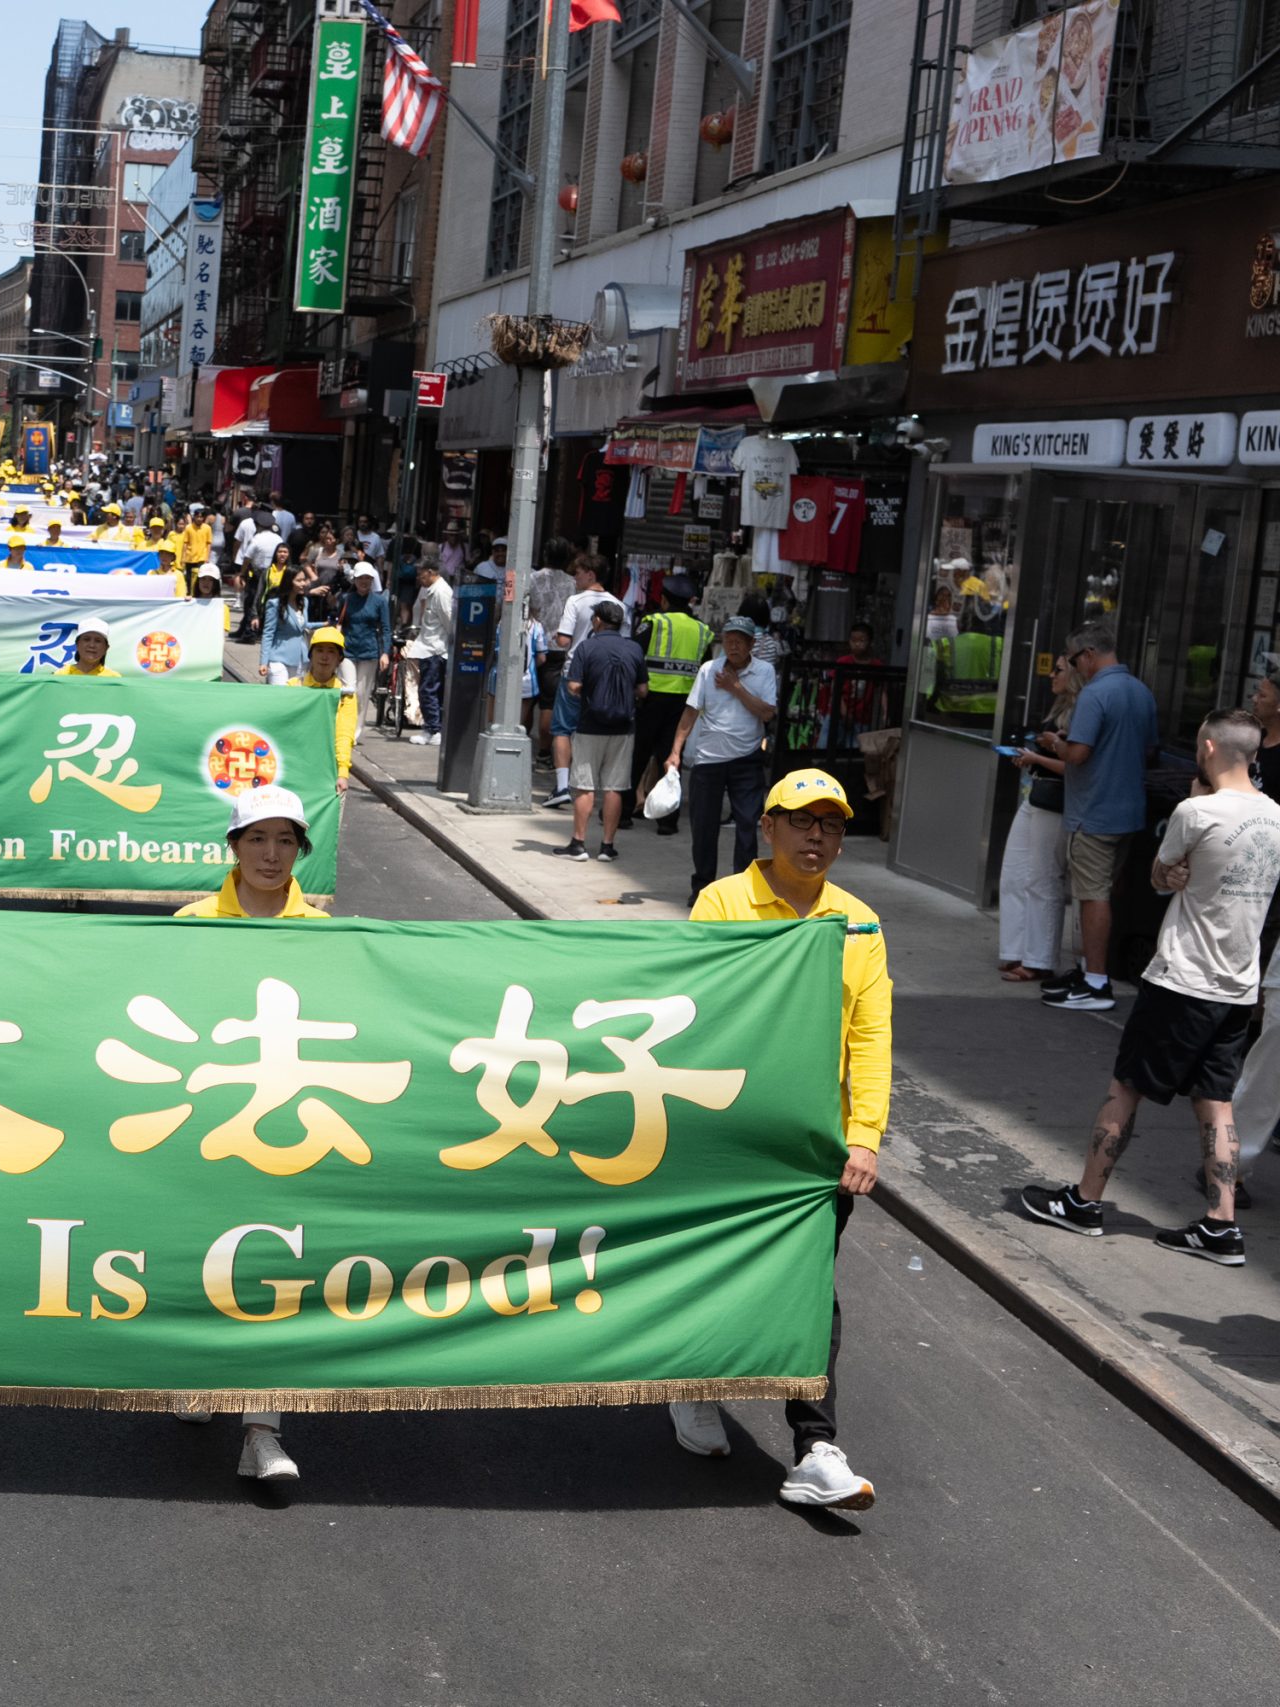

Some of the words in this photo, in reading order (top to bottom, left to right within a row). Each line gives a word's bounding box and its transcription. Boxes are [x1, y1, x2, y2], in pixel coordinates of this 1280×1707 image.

[991, 432, 1031, 456] KING'S
[1033, 432, 1090, 456] KITCHEN
[829, 501, 848, 535] 7
[469, 601, 484, 623] P
[1224, 817, 1263, 847] BILLABONG
[23, 1218, 149, 1322] Is
[202, 1222, 607, 1324] Good!
